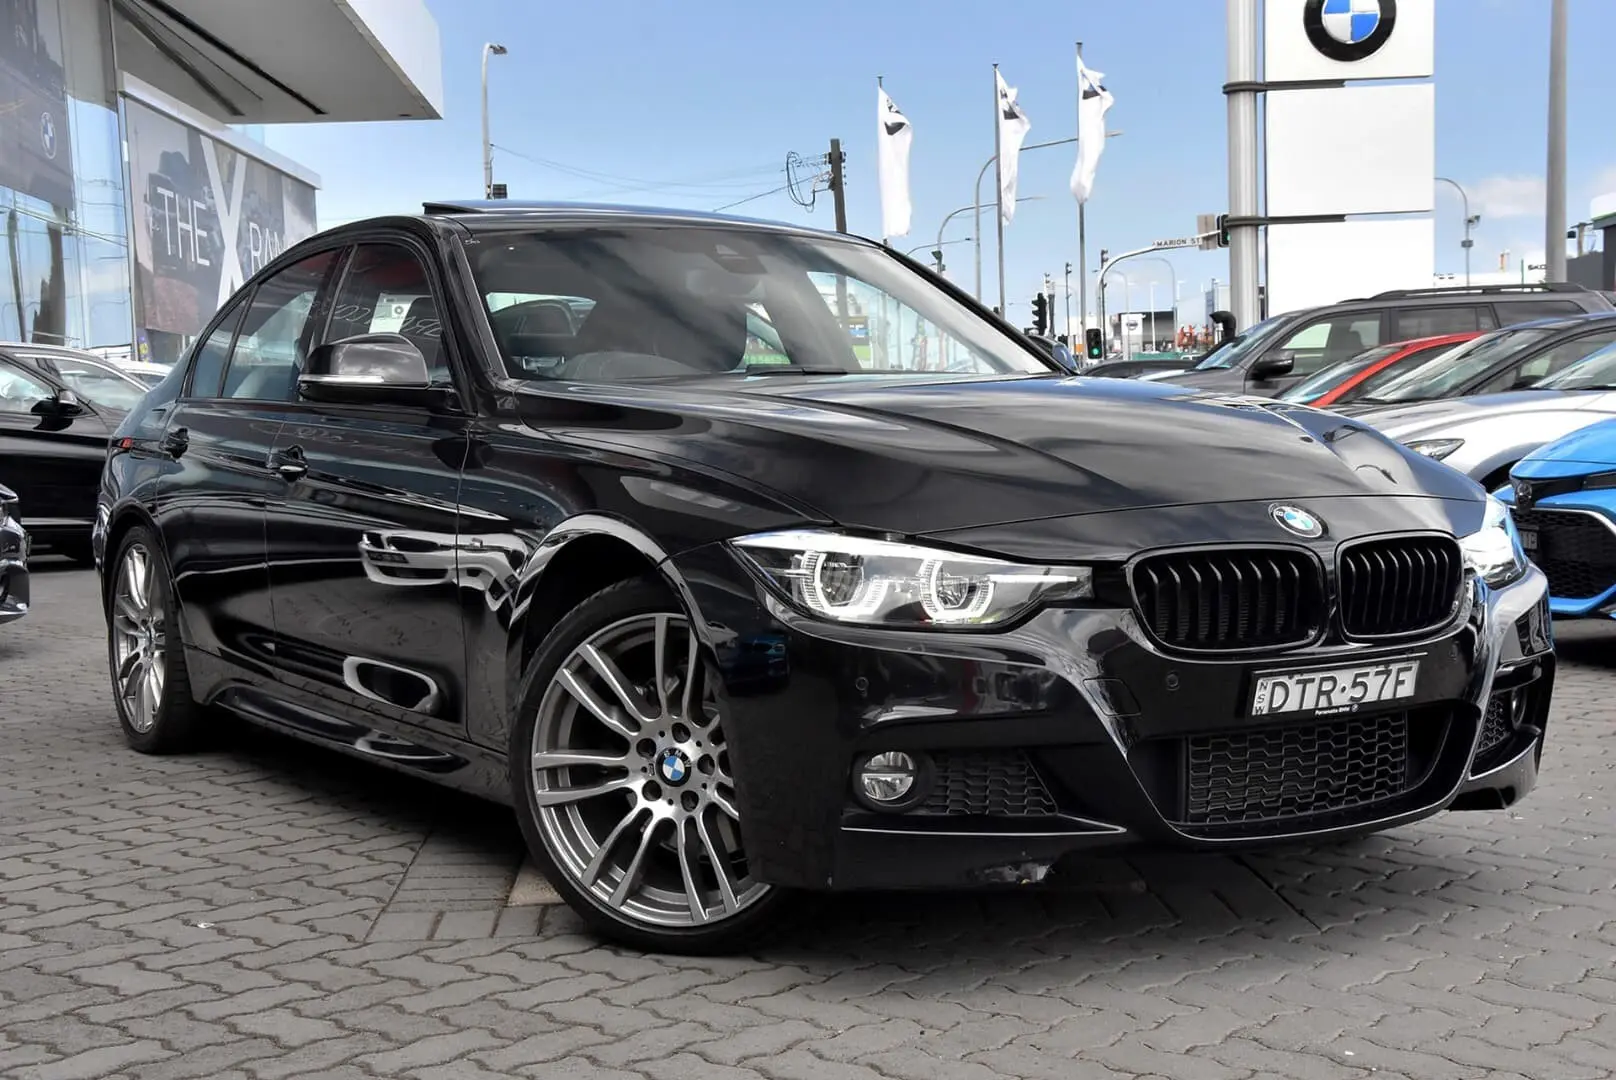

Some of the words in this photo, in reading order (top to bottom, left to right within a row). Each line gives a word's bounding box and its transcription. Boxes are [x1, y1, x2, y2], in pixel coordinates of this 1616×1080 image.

[157, 186, 210, 266] THE
[200, 133, 248, 312] X
[1156, 239, 1187, 247] MARION
